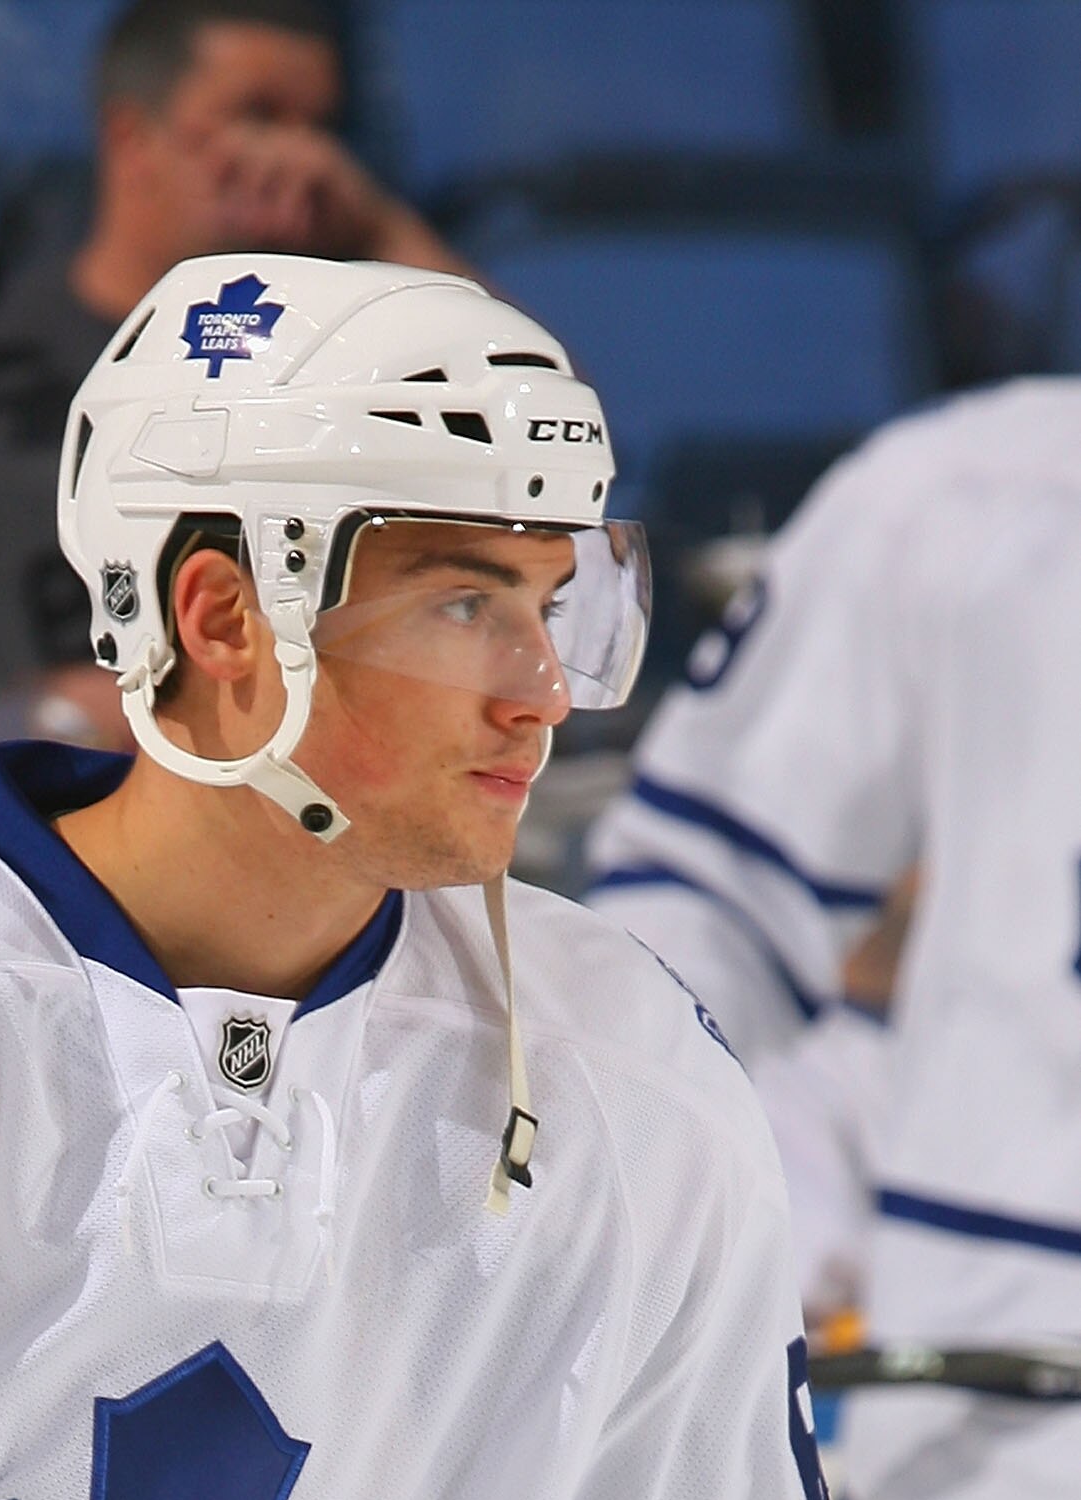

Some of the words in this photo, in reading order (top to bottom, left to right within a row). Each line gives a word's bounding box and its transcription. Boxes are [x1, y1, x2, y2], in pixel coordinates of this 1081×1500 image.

[198, 314, 260, 325] TORONTO
[201, 325, 244, 336] MAPLE
[200, 338, 239, 350] LEAFS
[527, 419, 604, 445] CCM
[230, 1035, 265, 1073] NHL
